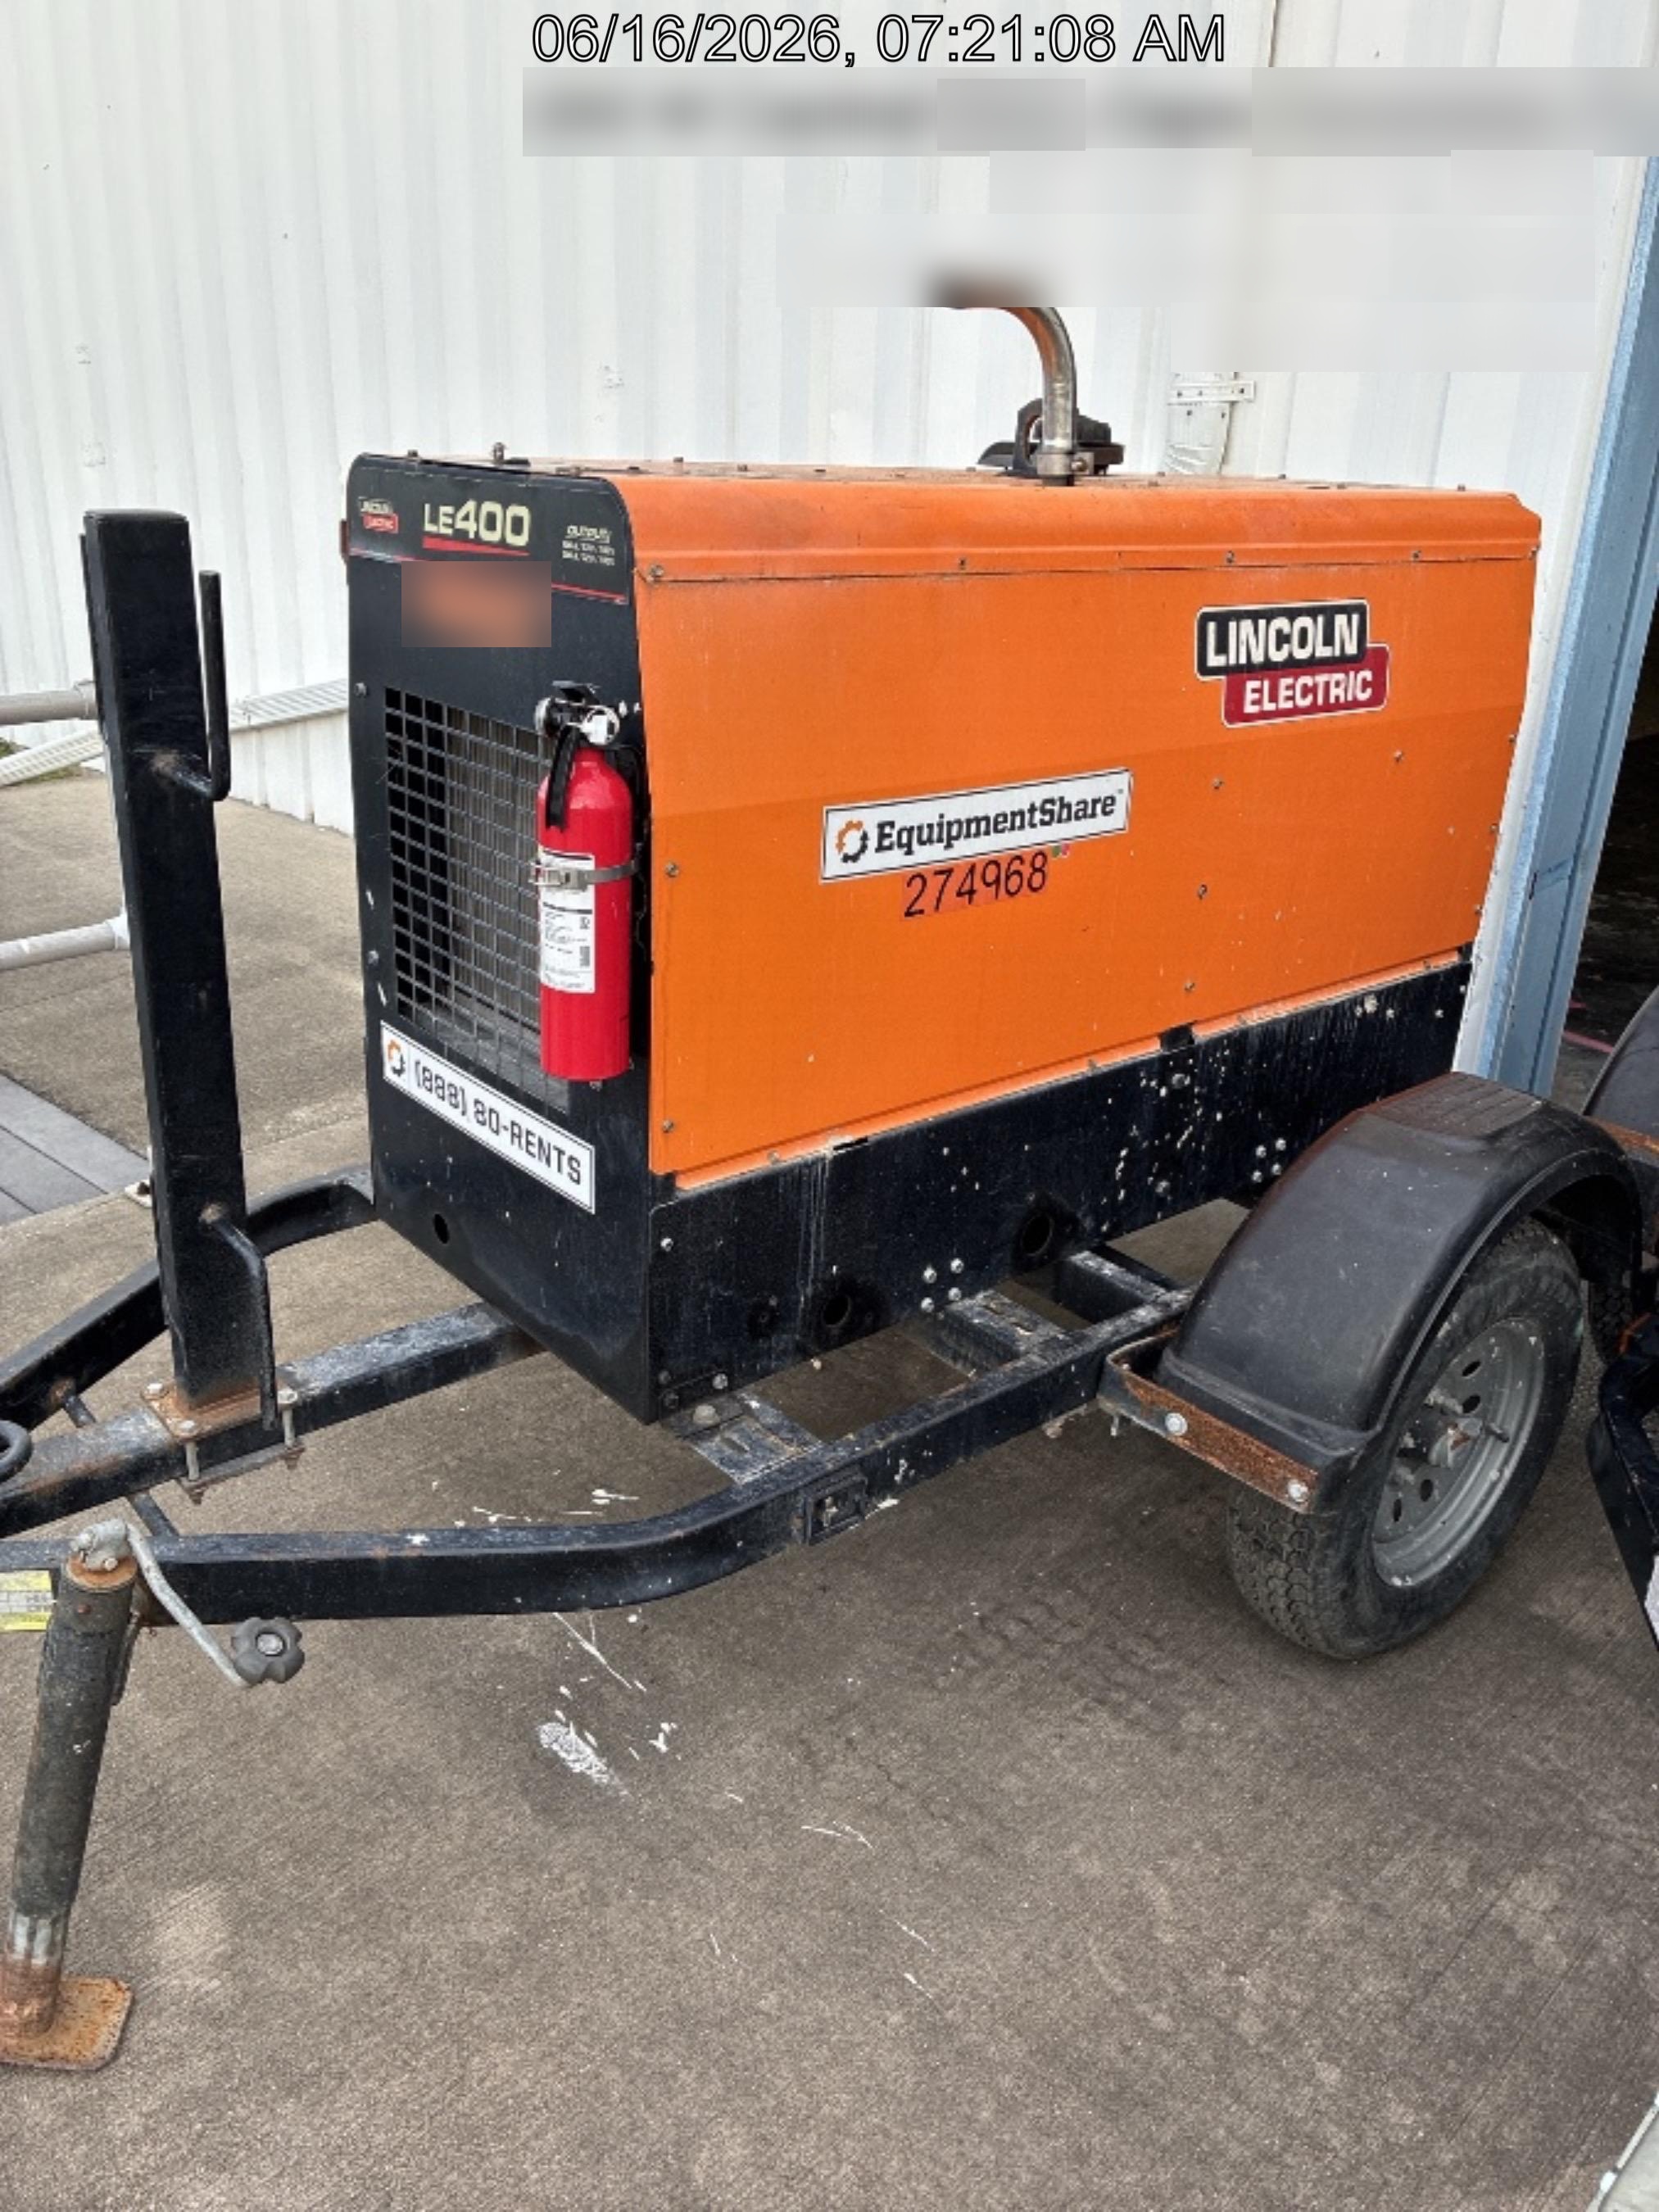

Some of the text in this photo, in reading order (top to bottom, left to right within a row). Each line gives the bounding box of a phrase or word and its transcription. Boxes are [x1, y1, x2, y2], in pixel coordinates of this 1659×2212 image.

[423, 499, 531, 547] LE400
[1206, 614, 1360, 667] LINCOLN
[1244, 670, 1372, 714] ELECTRIC
[874, 794, 1117, 856] EquipmentShare
[904, 851, 1049, 918] 274968
[415, 1059, 582, 1185] (888) 80-RENTS
